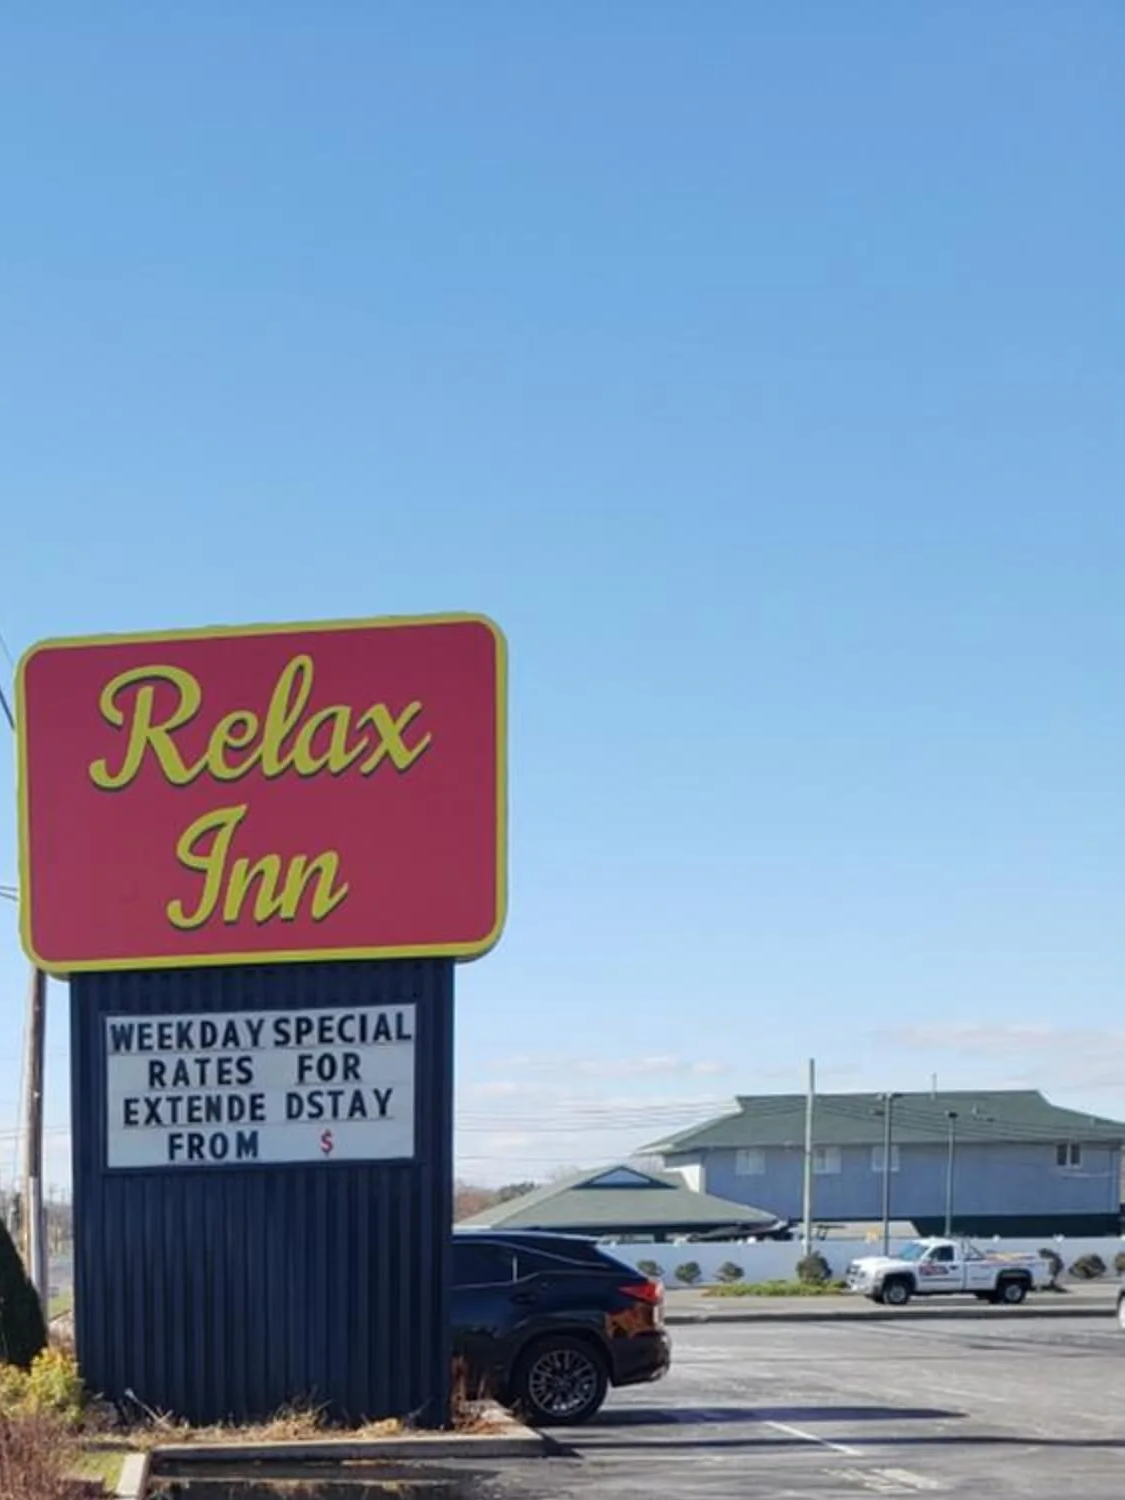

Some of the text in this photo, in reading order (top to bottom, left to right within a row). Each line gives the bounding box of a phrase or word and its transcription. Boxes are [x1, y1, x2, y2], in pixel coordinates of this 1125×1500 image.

[88, 654, 432, 790] Relax
[166, 804, 348, 929] Inn
[110, 1012, 412, 1051] WEEKDAY SPECIAL
[148, 1053, 362, 1088] RATES FOR
[123, 1088, 393, 1126] EXTENDE DSTAY
[168, 1129, 333, 1160] FROM $
